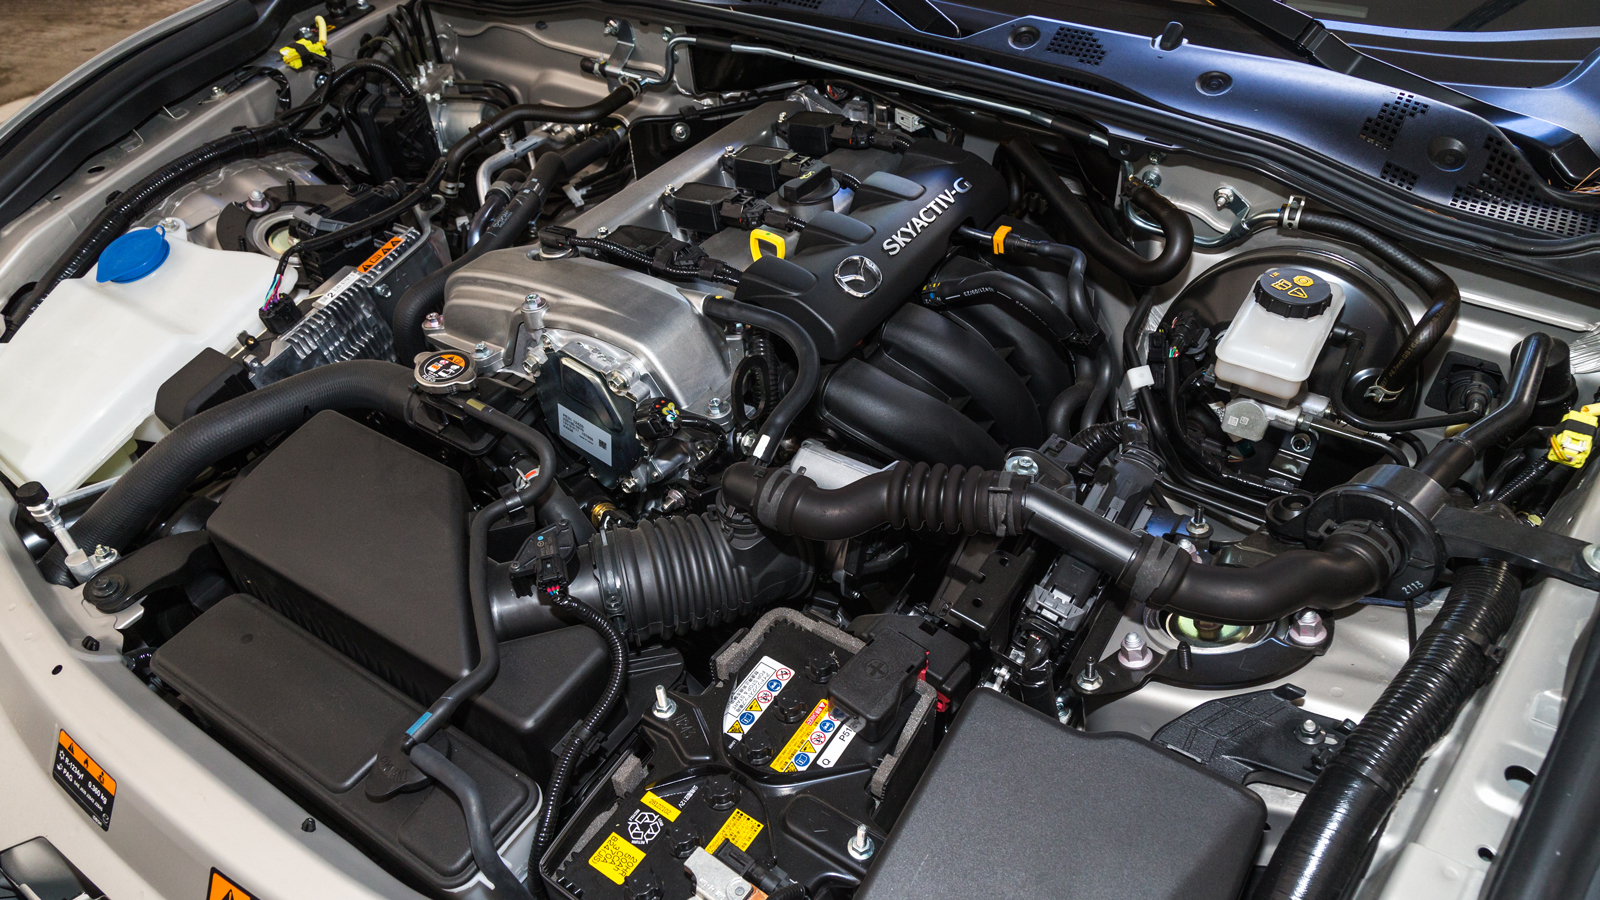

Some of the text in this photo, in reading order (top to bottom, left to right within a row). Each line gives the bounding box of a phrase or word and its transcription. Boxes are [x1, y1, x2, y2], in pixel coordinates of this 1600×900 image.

[882, 177, 973, 256] SKYACTIV-G
[1402, 580, 1424, 595] 2113
[63, 768, 73, 782] PAG
[600, 844, 620, 864] 370A
[610, 850, 624, 866] CCA
[613, 852, 631, 872] 50Ah
[619, 856, 638, 877] 20HR
